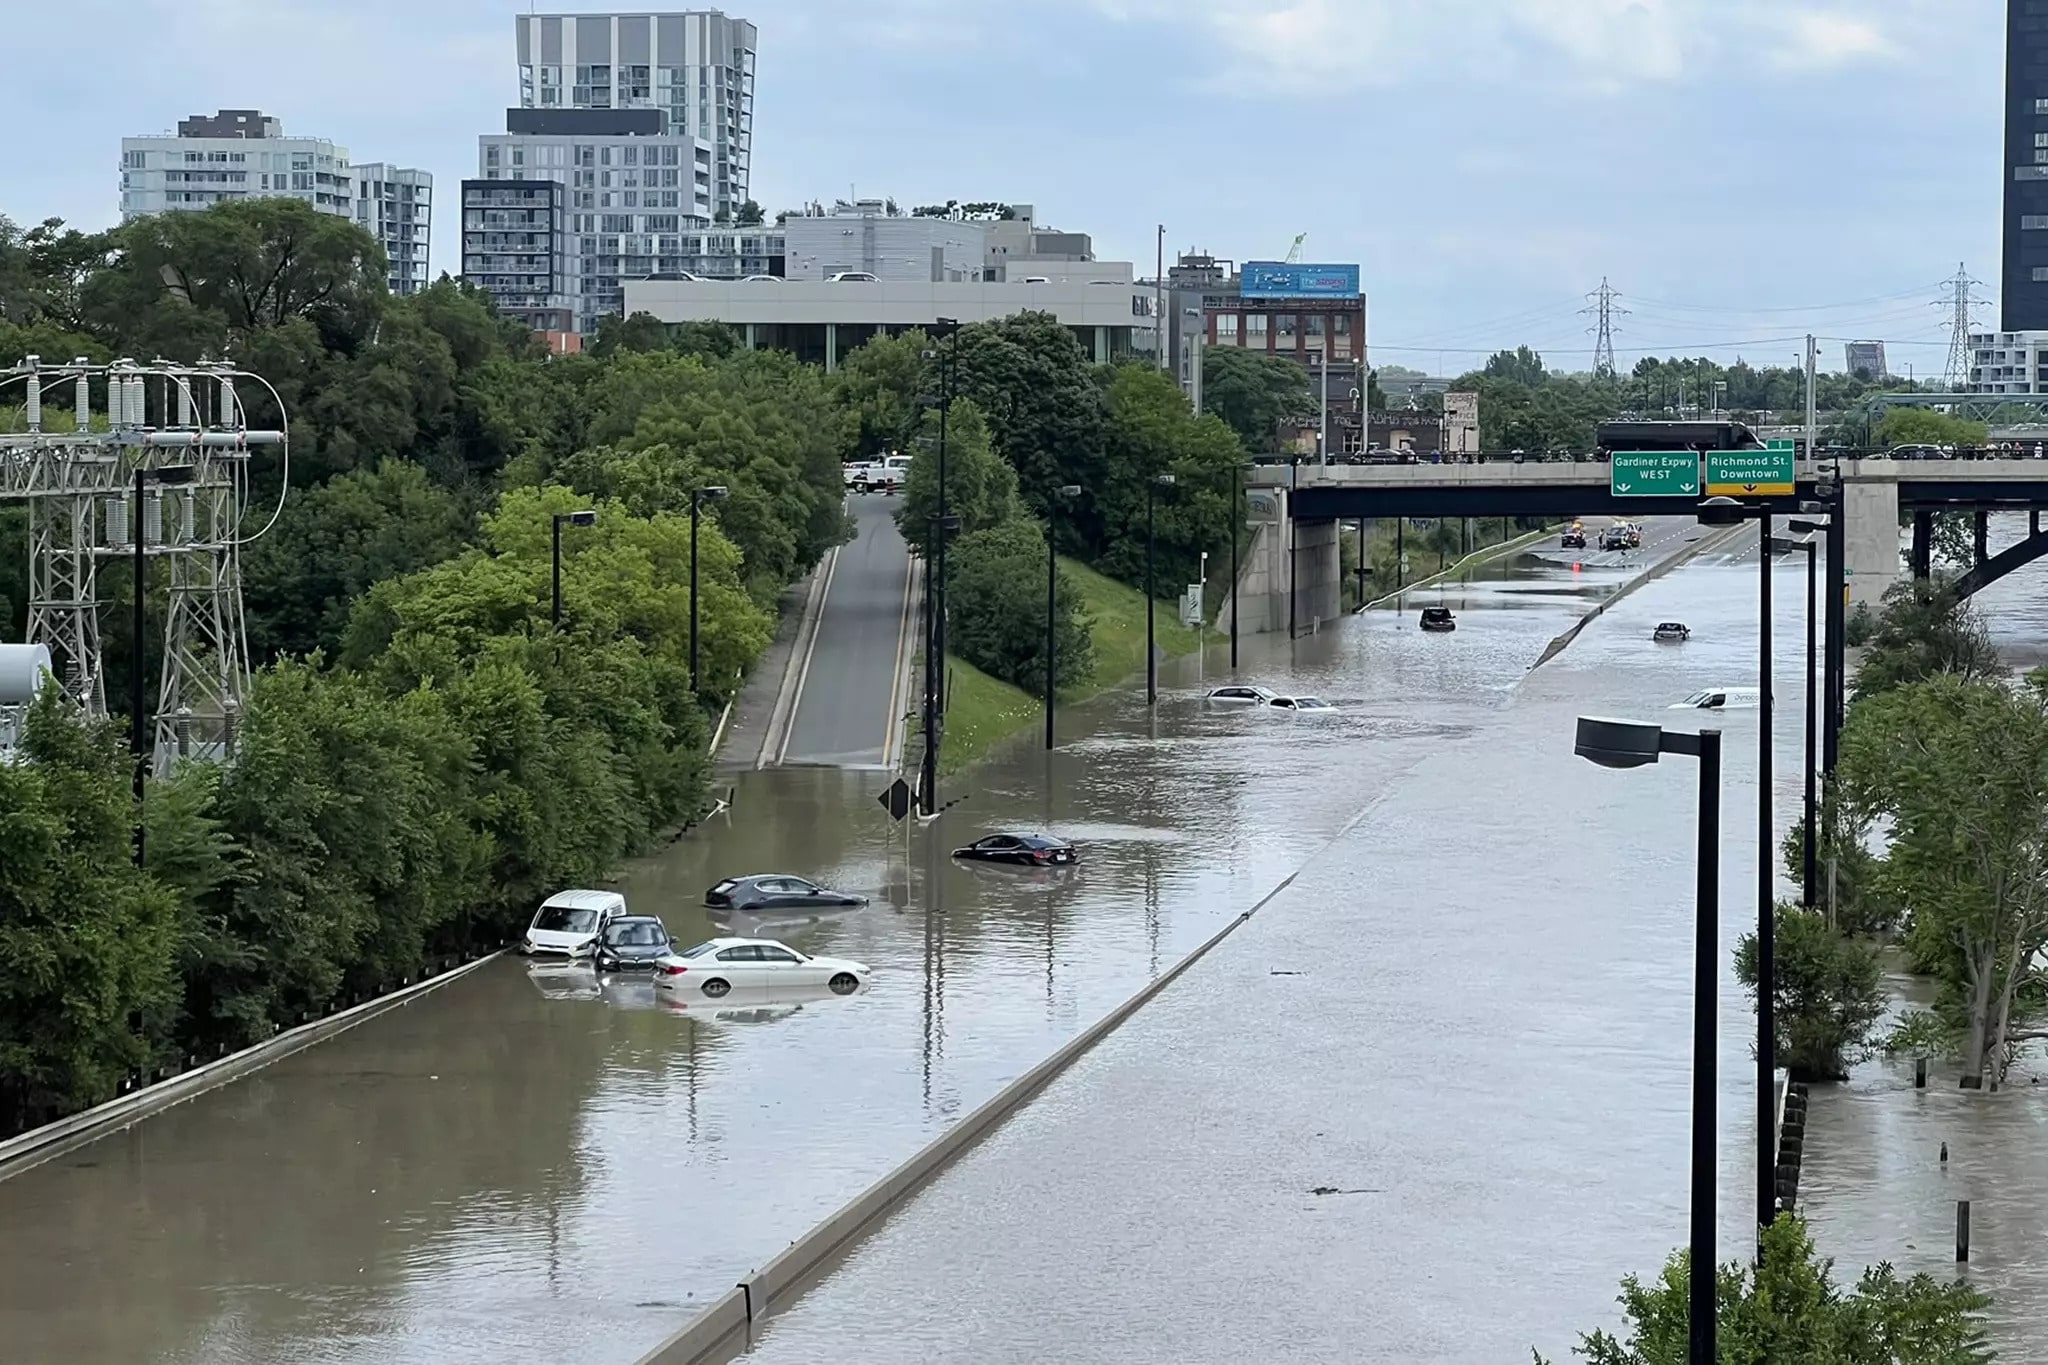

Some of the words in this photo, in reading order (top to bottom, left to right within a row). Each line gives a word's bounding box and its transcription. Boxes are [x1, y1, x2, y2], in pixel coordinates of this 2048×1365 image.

[1615, 457, 1658, 467] Gardiner
[1661, 457, 1695, 468] Expwy.
[1711, 457, 1768, 466] Richmond
[1772, 456, 1789, 466] St.
[1640, 470, 1671, 479] WEST
[1720, 469, 1779, 479] Downtown
